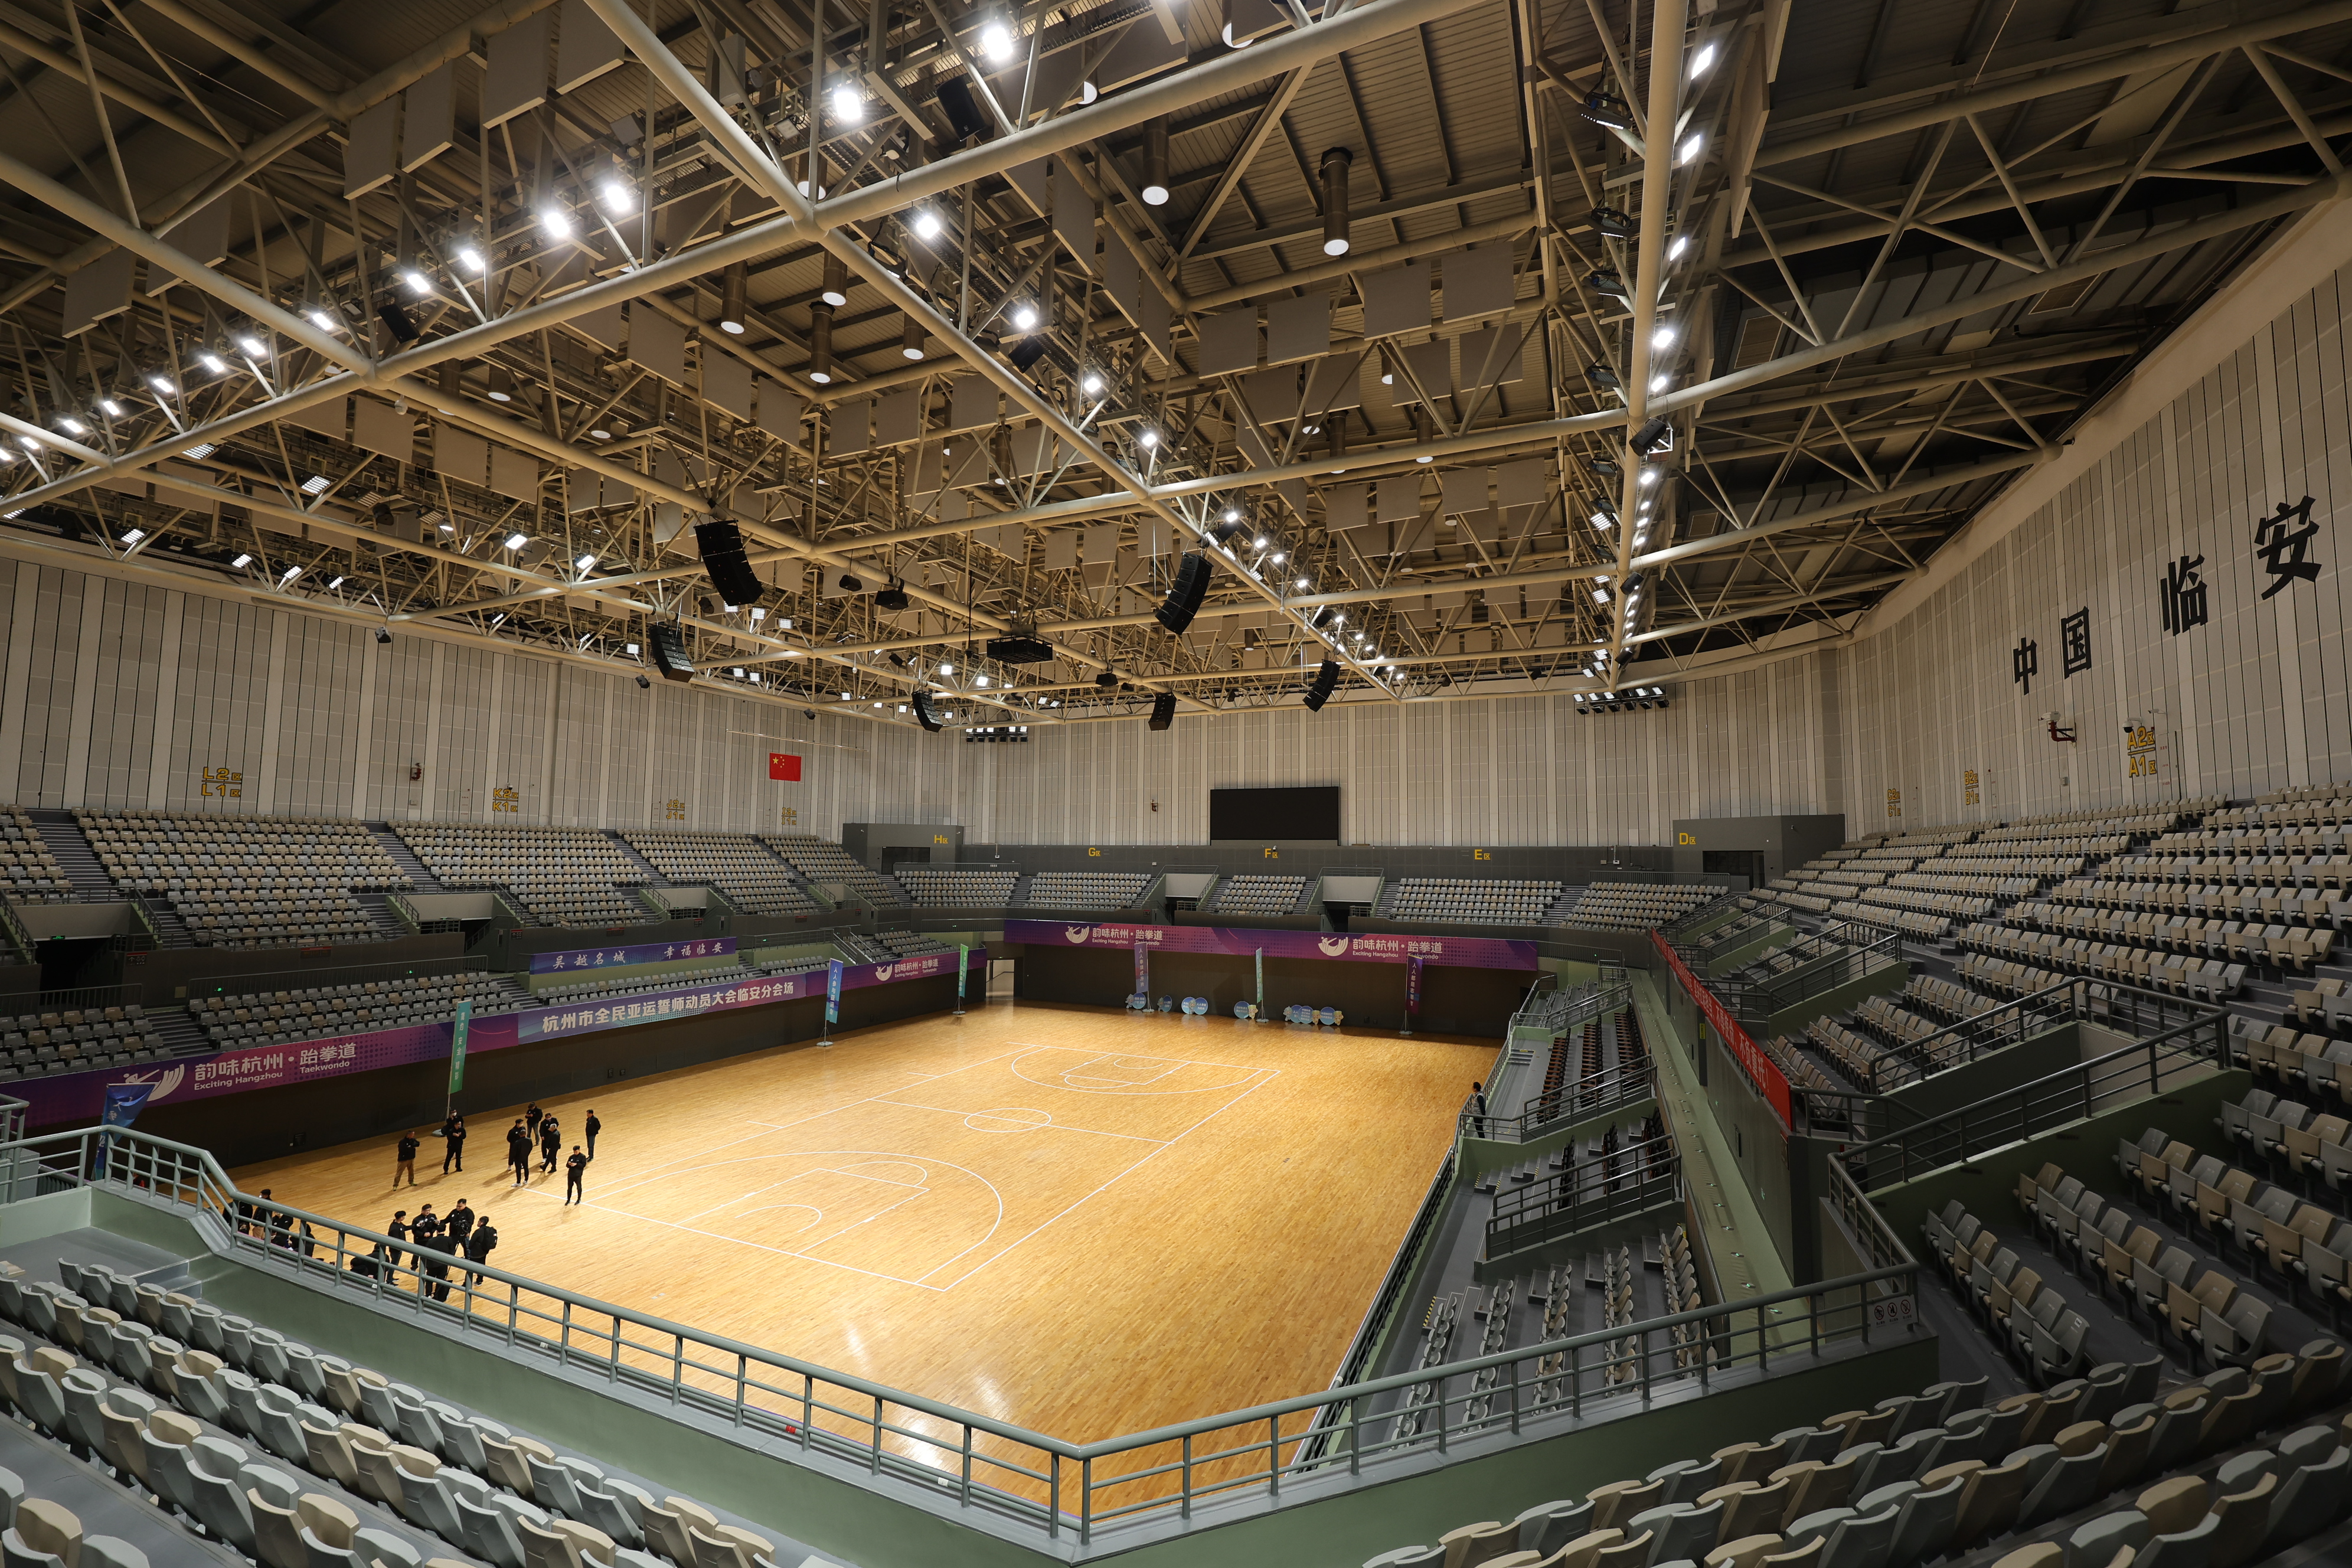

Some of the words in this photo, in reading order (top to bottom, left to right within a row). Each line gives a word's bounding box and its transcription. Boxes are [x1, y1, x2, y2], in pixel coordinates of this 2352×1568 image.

[2013, 606, 2092, 695] 中国
[2160, 495, 2322, 636] 临安
[202, 767, 242, 781] L2区
[2129, 755, 2157, 778] A1区
[201, 784, 240, 798] L1区
[1679, 832, 1696, 845] D区
[553, 950, 626, 969] 吴越名城
[664, 942, 723, 959] 幸福临安
[543, 982, 794, 1033] 杭州市全民亚运誓师动员大会临安分会场
[194, 1077, 233, 1091] Exciting
[236, 1071, 283, 1084] Hangzhou
[300, 1060, 350, 1074] Taekwondo
